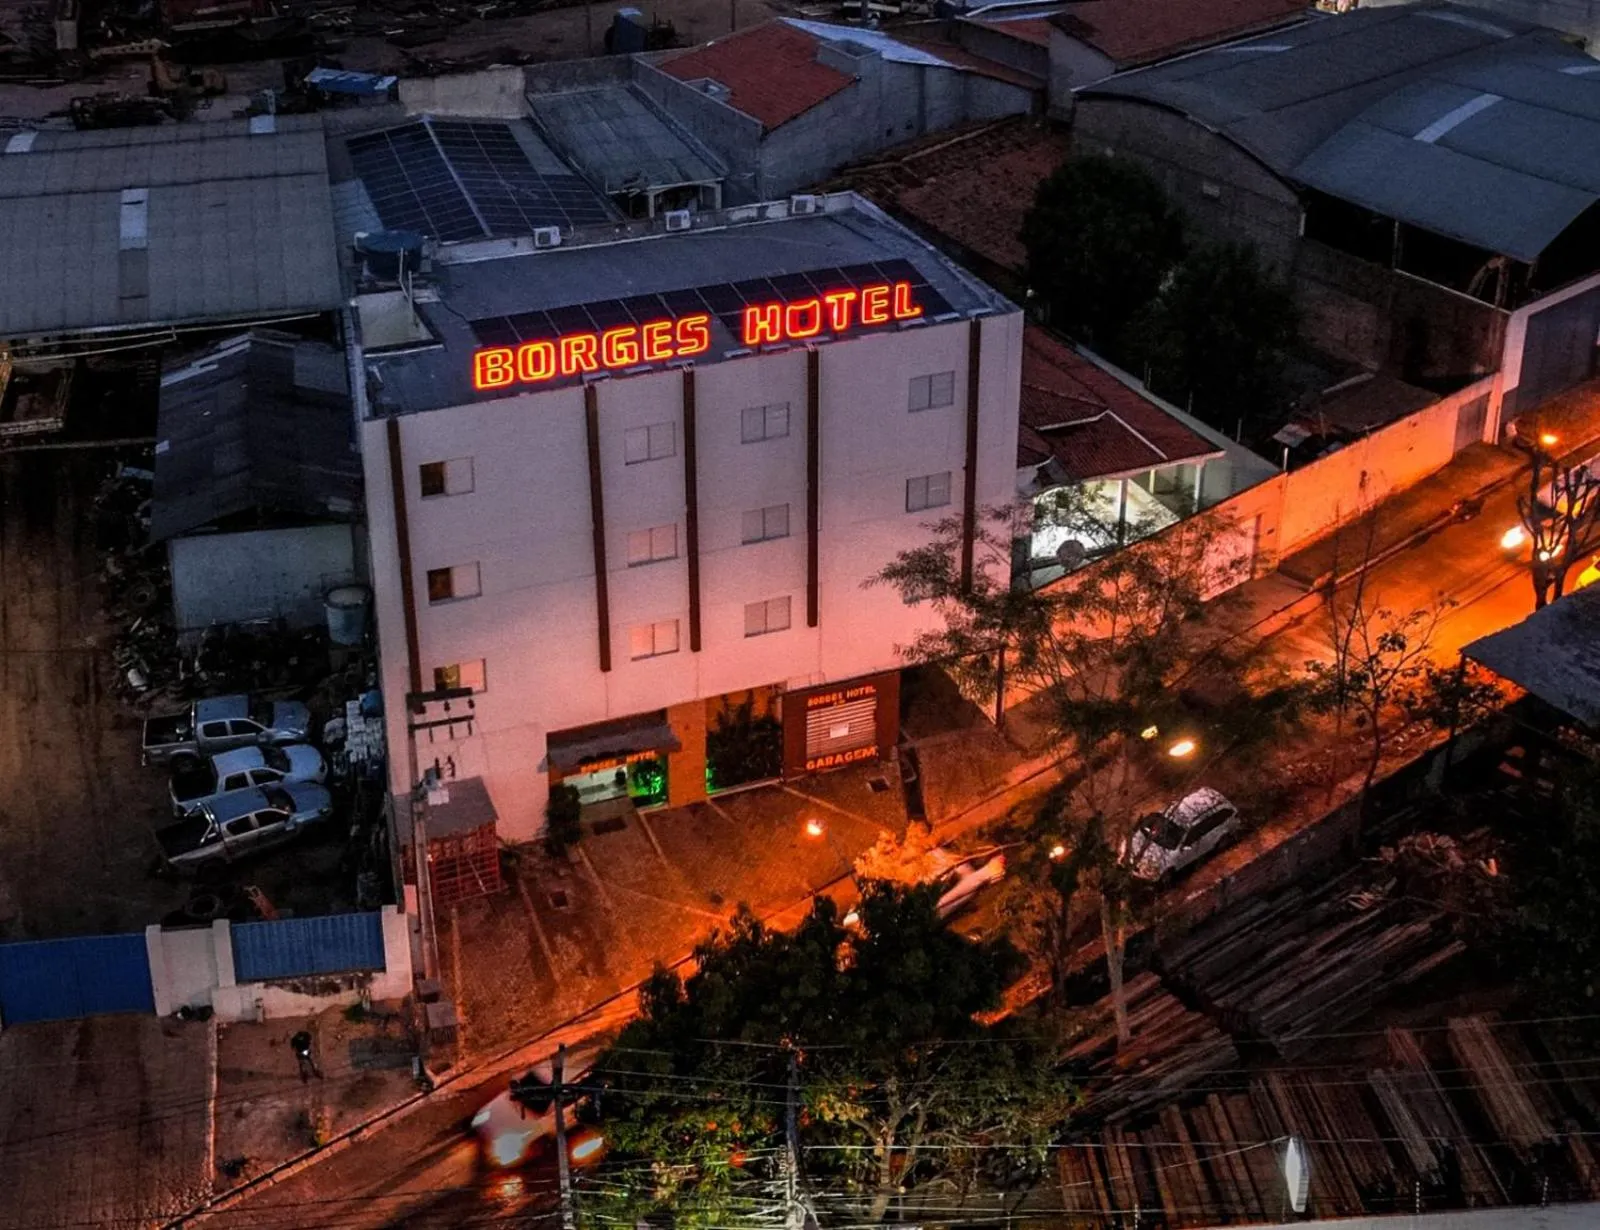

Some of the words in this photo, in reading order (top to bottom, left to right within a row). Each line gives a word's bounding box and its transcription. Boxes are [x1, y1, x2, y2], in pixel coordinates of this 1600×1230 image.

[473, 314, 710, 392] BORGES
[744, 282, 924, 346] HOTEL
[806, 746, 877, 770] GARAGEM
